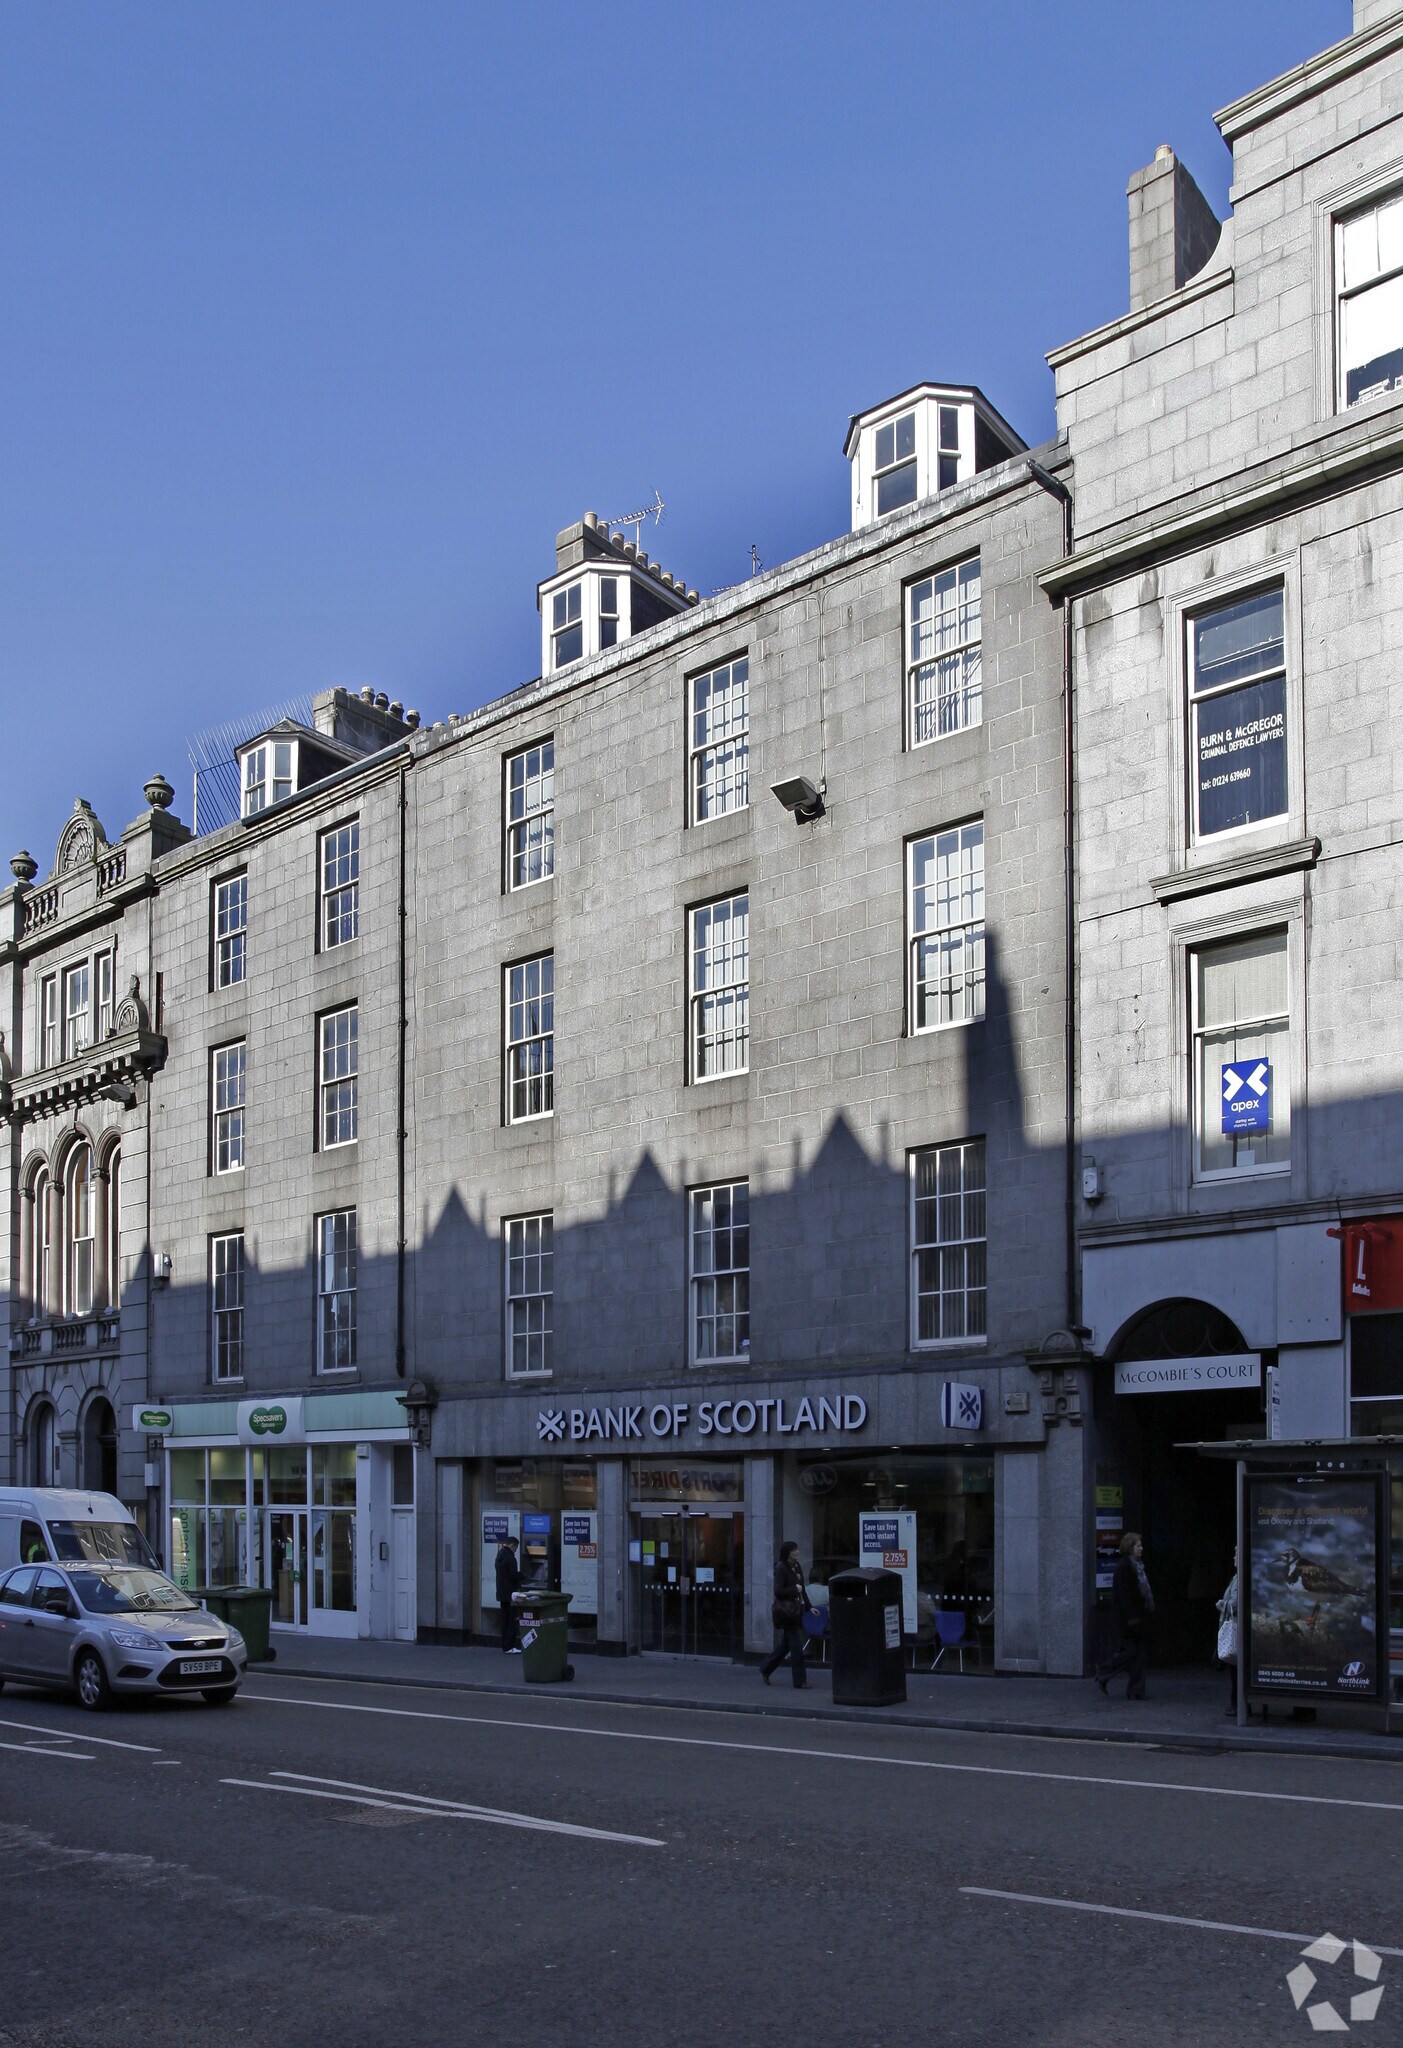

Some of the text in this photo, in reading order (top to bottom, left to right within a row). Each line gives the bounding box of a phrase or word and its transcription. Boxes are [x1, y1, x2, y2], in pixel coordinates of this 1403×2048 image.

[1200, 713, 1284, 749] BURN & McGREGOR
[1200, 728, 1284, 760] CRIMINAL DEFENCE LAWYERS
[1212, 774, 1229, 787] 01224
[1231, 1099, 1259, 1113] apex
[1119, 1364, 1256, 1383] McCOMBIE'S COURT
[143, 1413, 168, 1422] Specsavers
[253, 1413, 283, 1424] Specsavers
[570, 1394, 868, 1439] BANK OF SCOTLAND
[1258, 1506, 1294, 1515] Discover
[1342, 1505, 1368, 1515] world
[565, 1519, 575, 1527] Save
[864, 1523, 876, 1531] Save
[886, 1523, 897, 1531] free
[1270, 1517, 1292, 1527] Orkney
[1293, 1517, 1305, 1525] and
[1306, 1517, 1334, 1525] Shetland
[864, 1532, 896, 1540] with instant
[580, 1544, 596, 1554] 2.75%
[884, 1553, 905, 1562] 2.75%
[183, 1661, 219, 1672] SV59 BPE
[1257, 1677, 1328, 1687] www.northlinkferries.co.uk
[1337, 1677, 1371, 1685] NorthLink
